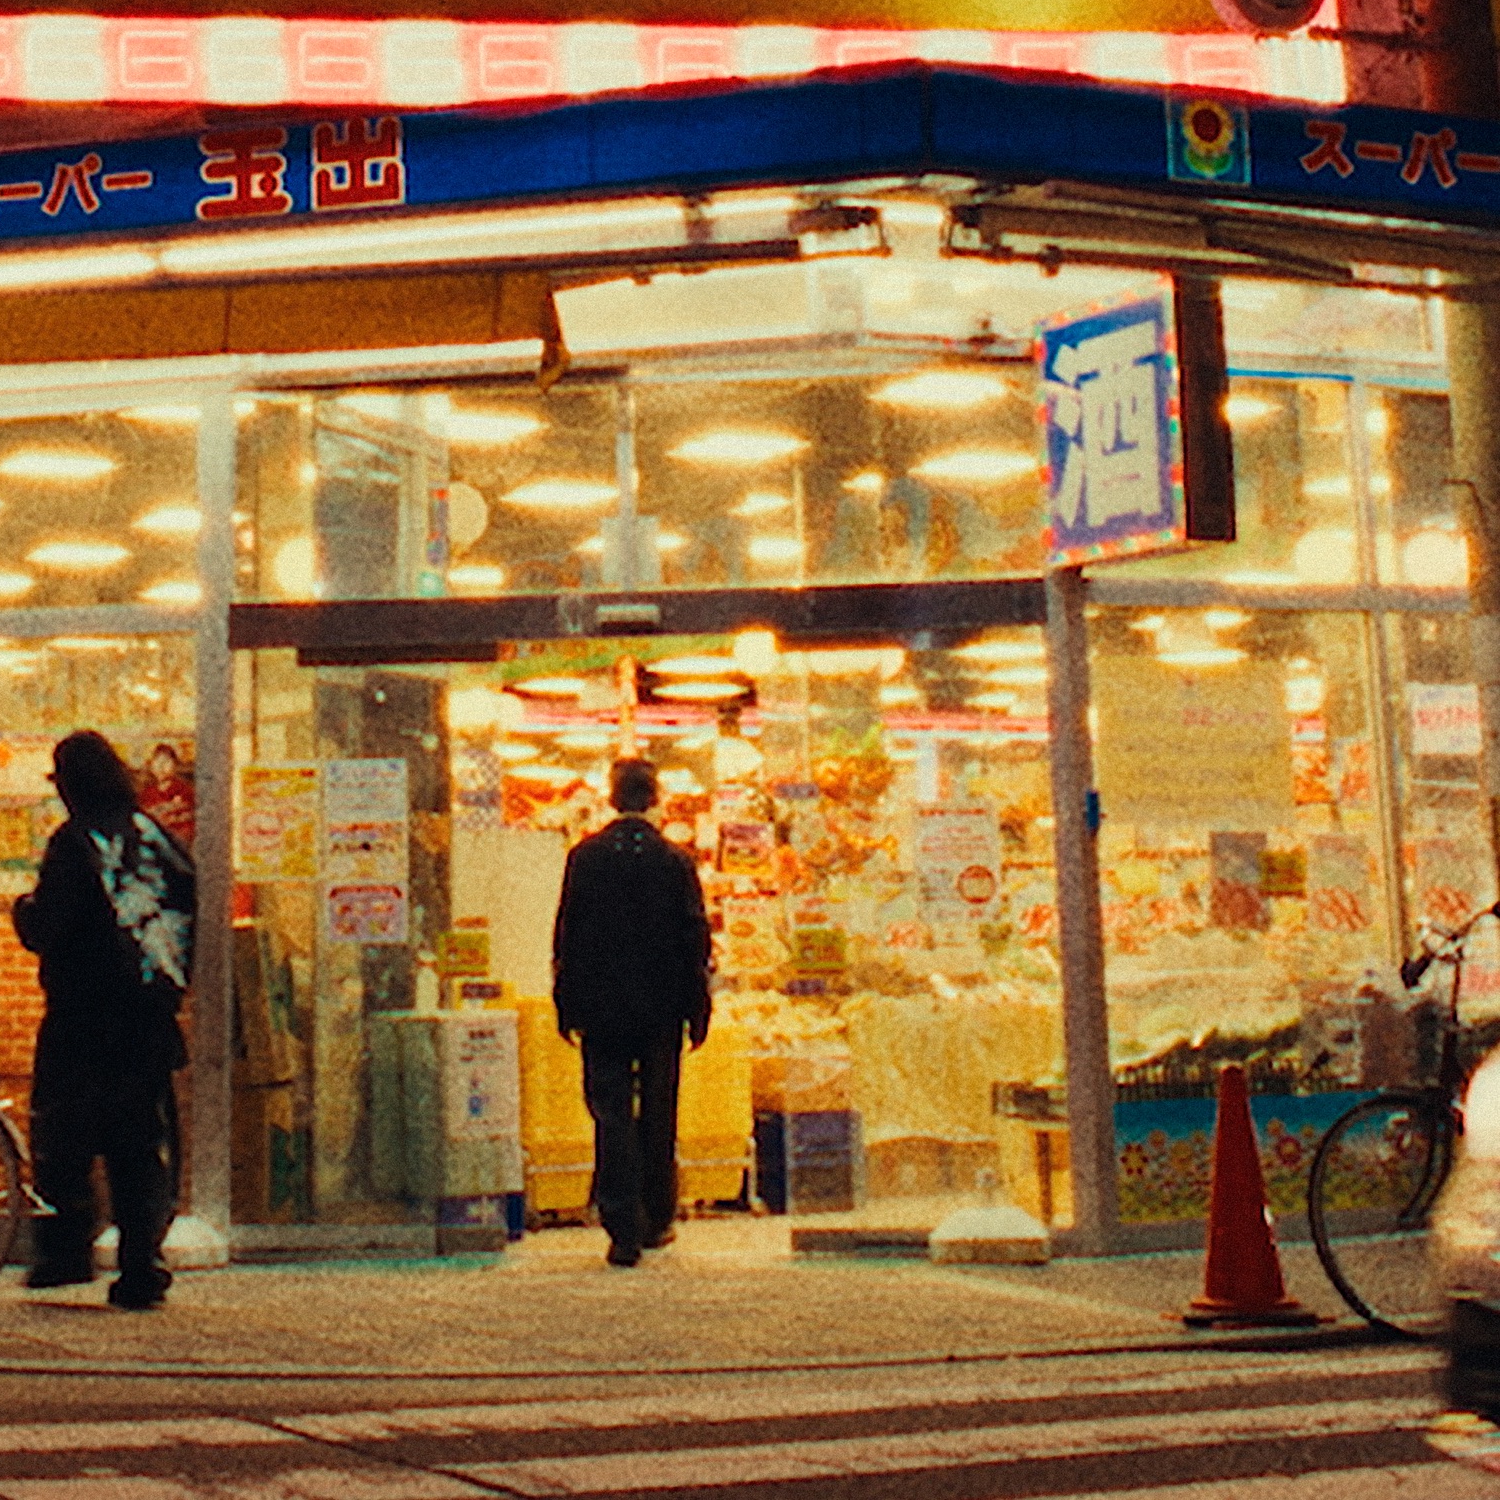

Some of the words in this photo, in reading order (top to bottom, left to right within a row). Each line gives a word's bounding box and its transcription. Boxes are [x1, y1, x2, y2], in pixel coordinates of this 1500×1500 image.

[196, 117, 405, 221] 玉出
[1299, 120, 1500, 188] スーパー
[1049, 315, 1174, 534] 酒
